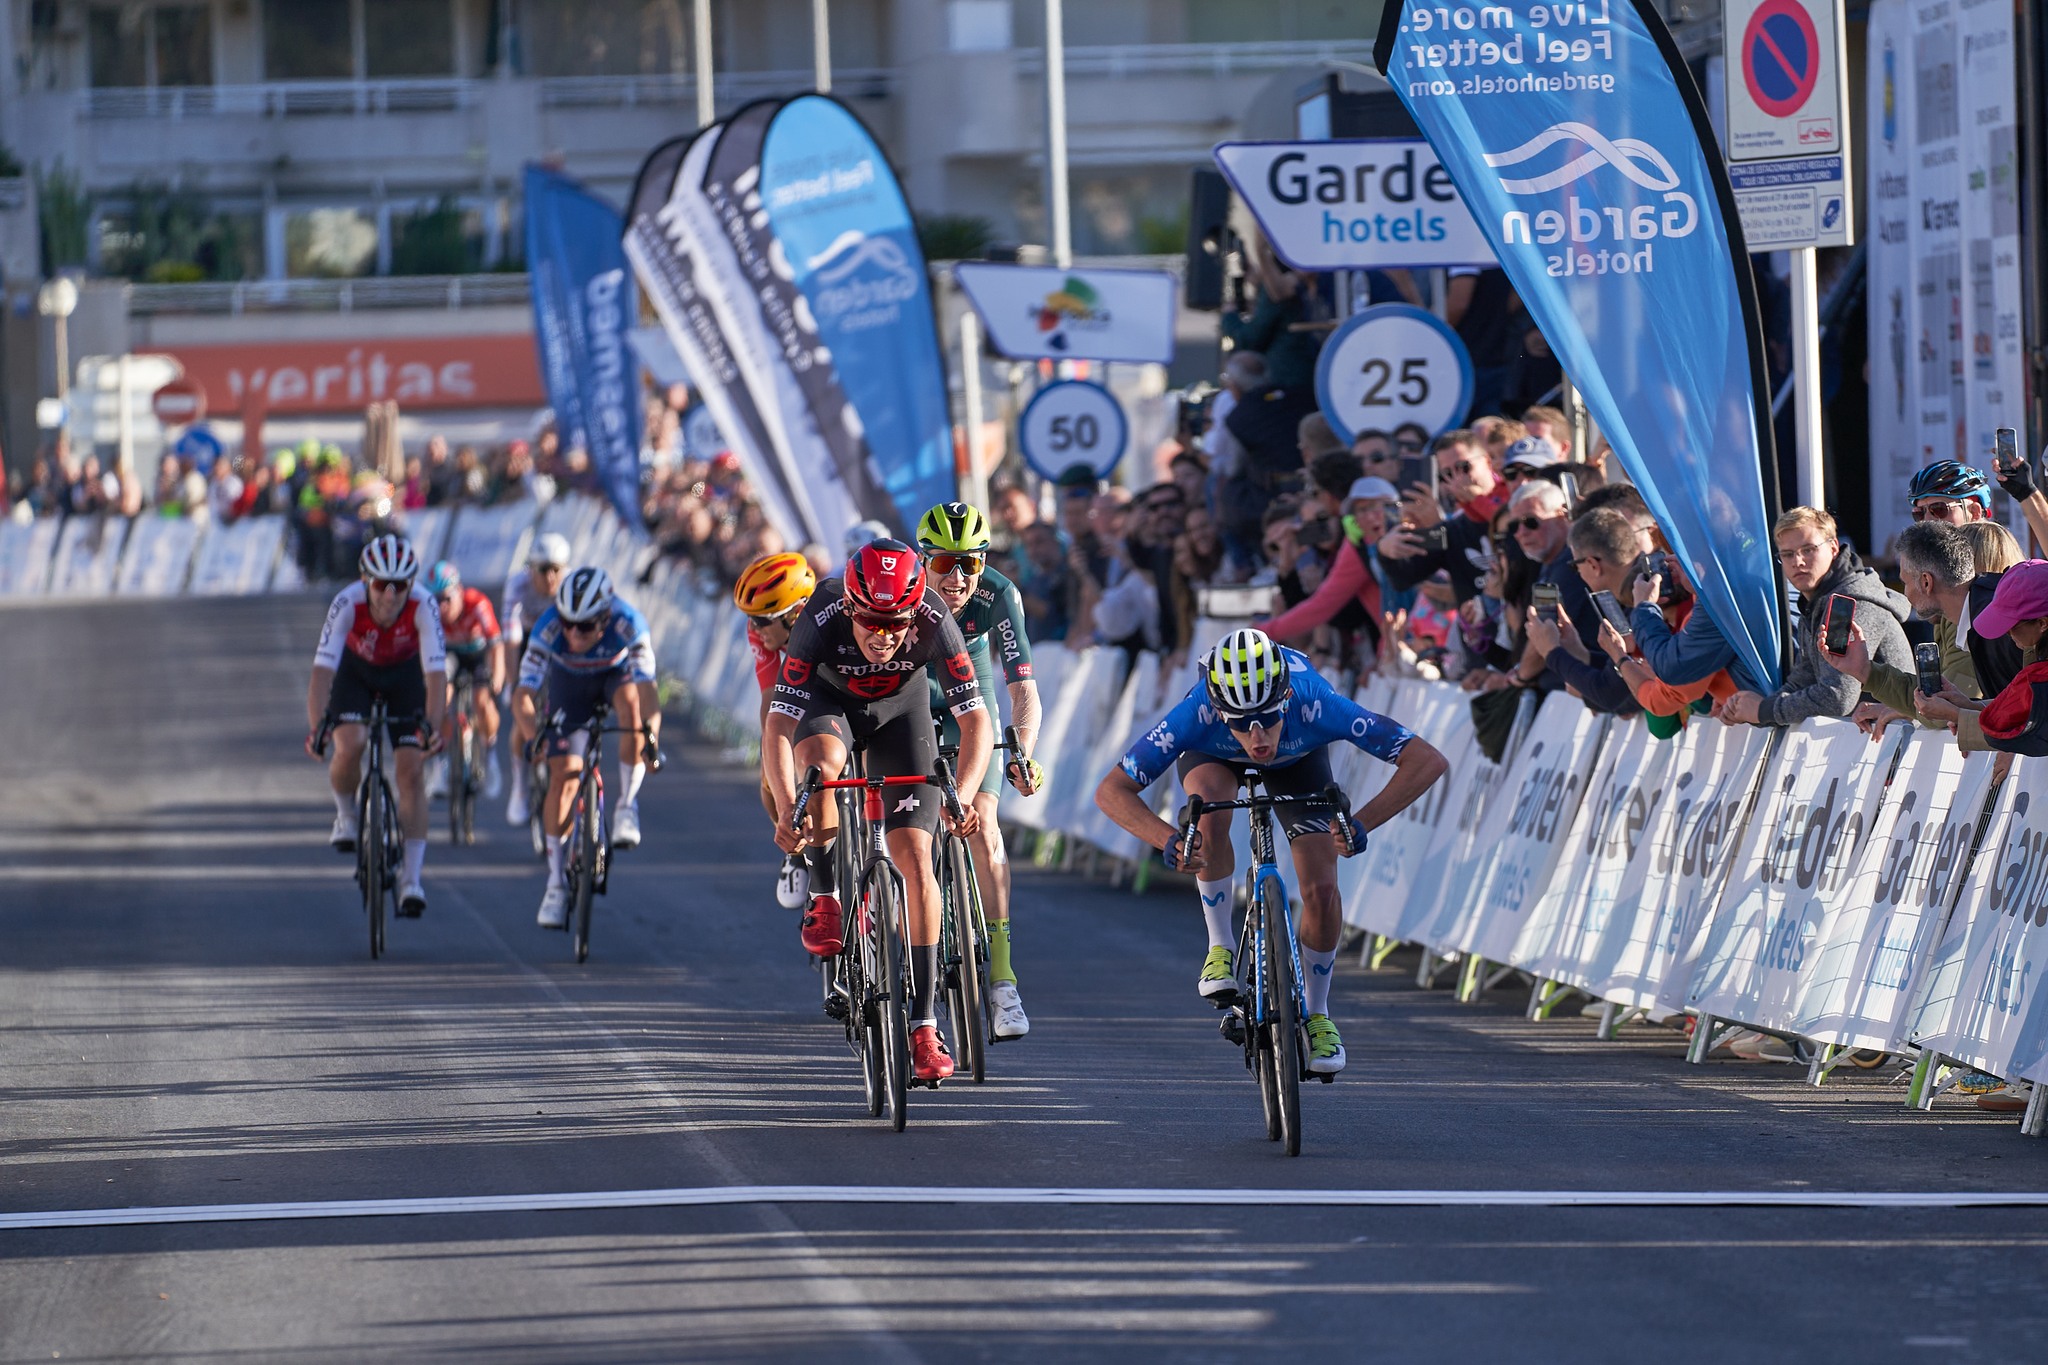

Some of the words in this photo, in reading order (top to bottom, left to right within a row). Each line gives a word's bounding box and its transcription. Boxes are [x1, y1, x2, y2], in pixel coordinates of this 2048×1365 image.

[1267, 149, 1455, 206] Garde
[1322, 209, 1447, 244] hotels
[227, 348, 476, 404] veritas
[1360, 358, 1429, 407] 25
[1049, 413, 1099, 452] 50
[974, 588, 995, 602] BORA
[814, 598, 845, 627] BMC
[917, 601, 944, 624] MC
[997, 618, 1021, 663] BORA
[837, 661, 915, 677] TUDOR
[946, 679, 980, 697] TUDO
[1146, 720, 1168, 741] vivo
